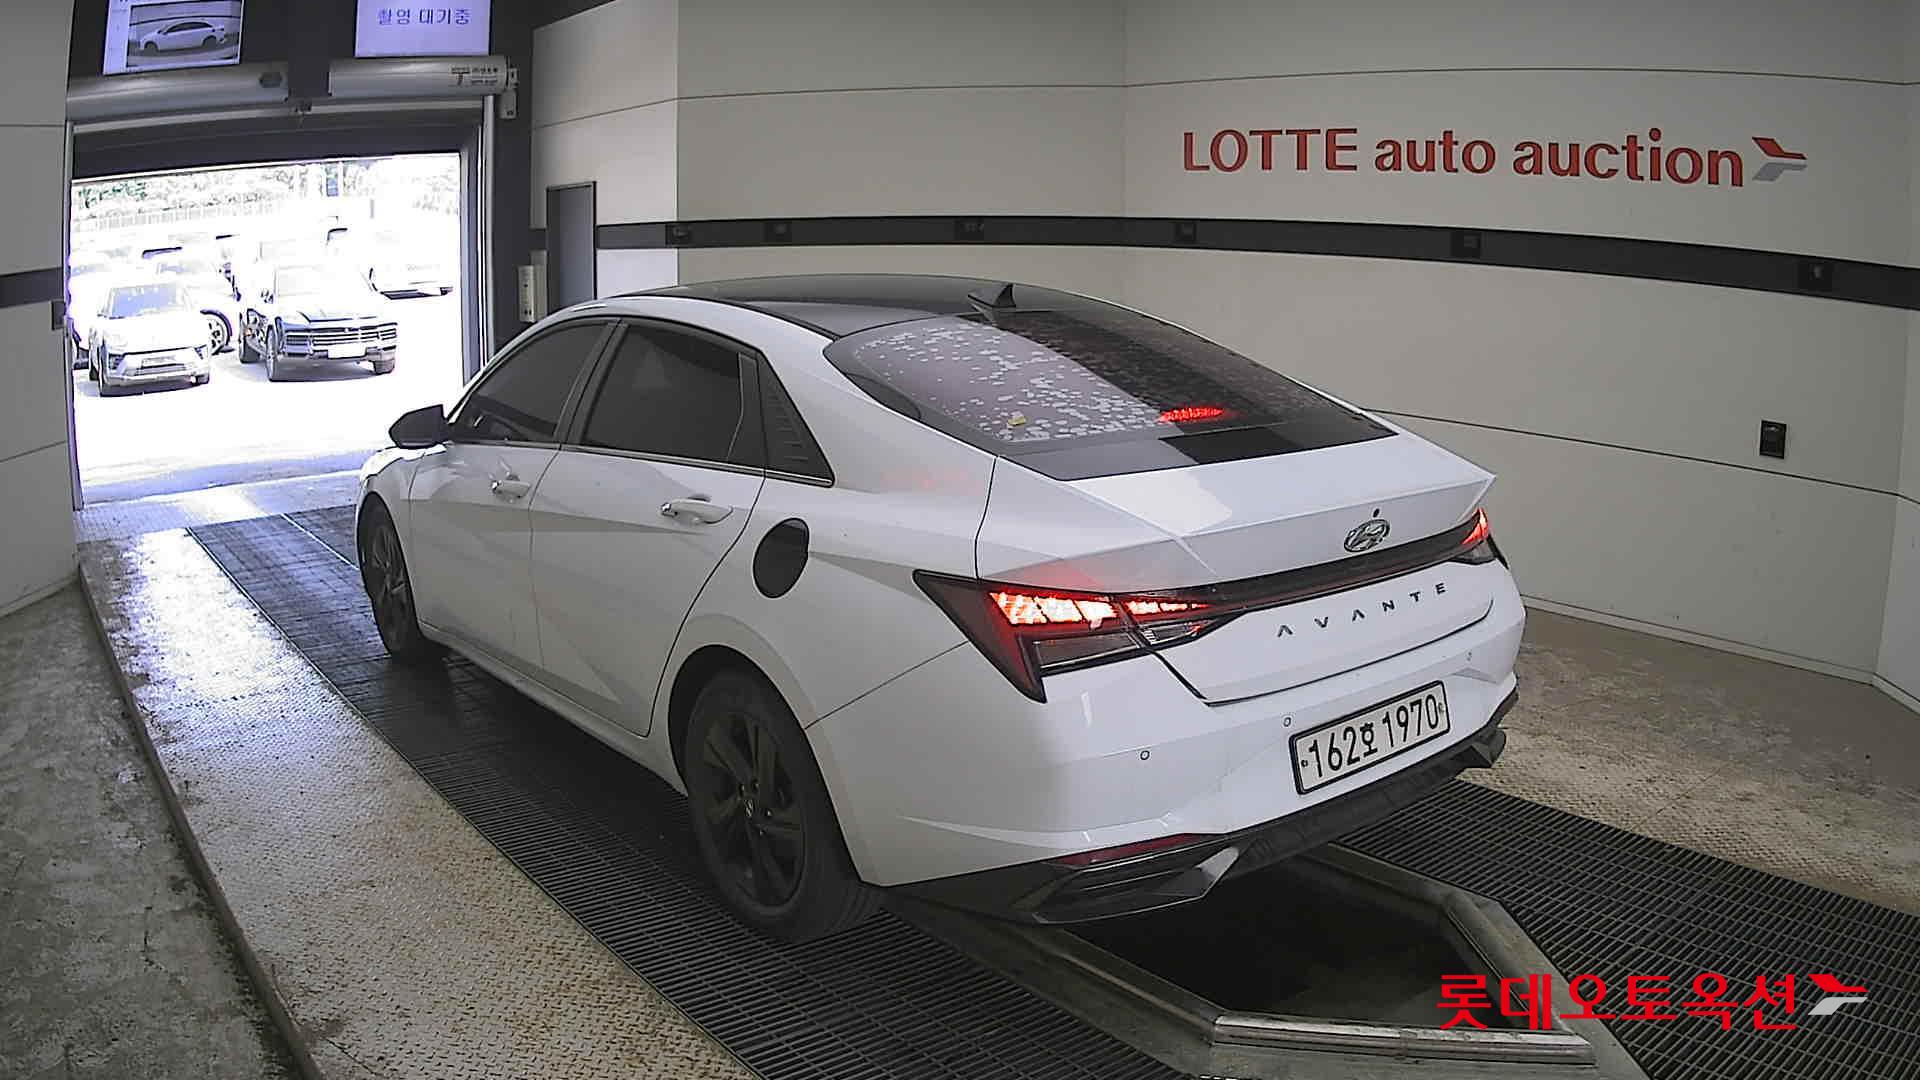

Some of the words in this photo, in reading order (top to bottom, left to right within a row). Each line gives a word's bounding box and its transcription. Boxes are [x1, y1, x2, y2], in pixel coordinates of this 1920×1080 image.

[378, 8, 411, 26] 촬영
[419, 8, 469, 25] 대기중
[1184, 128, 1358, 173] LOTTE
[1374, 130, 1496, 174] auto
[1513, 127, 1744, 187] auction
[1277, 582, 1447, 638] AVANTE
[1308, 722, 1378, 778] 162호
[1382, 694, 1439, 748] 1970
